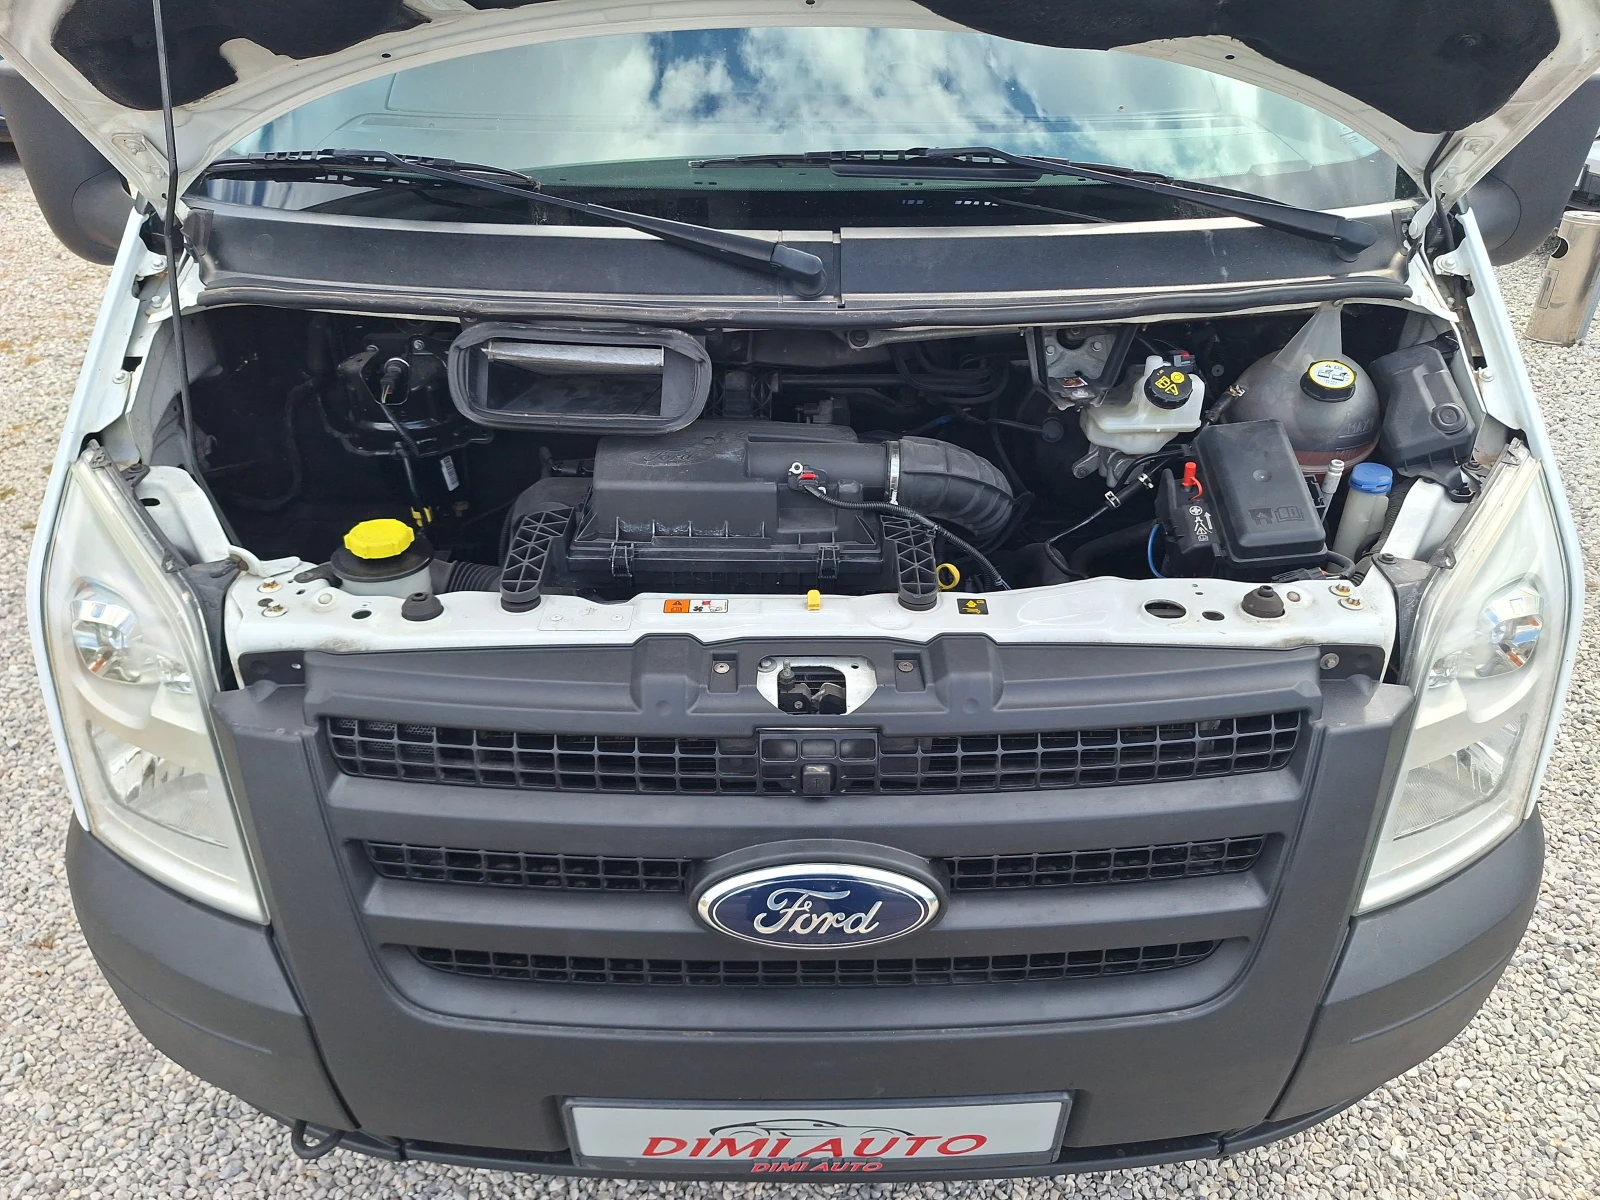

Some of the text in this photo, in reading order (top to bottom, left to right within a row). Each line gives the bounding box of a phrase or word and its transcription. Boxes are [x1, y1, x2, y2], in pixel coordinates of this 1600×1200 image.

[754, 887, 882, 934] Ford
[642, 1134, 988, 1157] DIMI AUTO
[751, 1161, 883, 1173] DIMI AUTO
